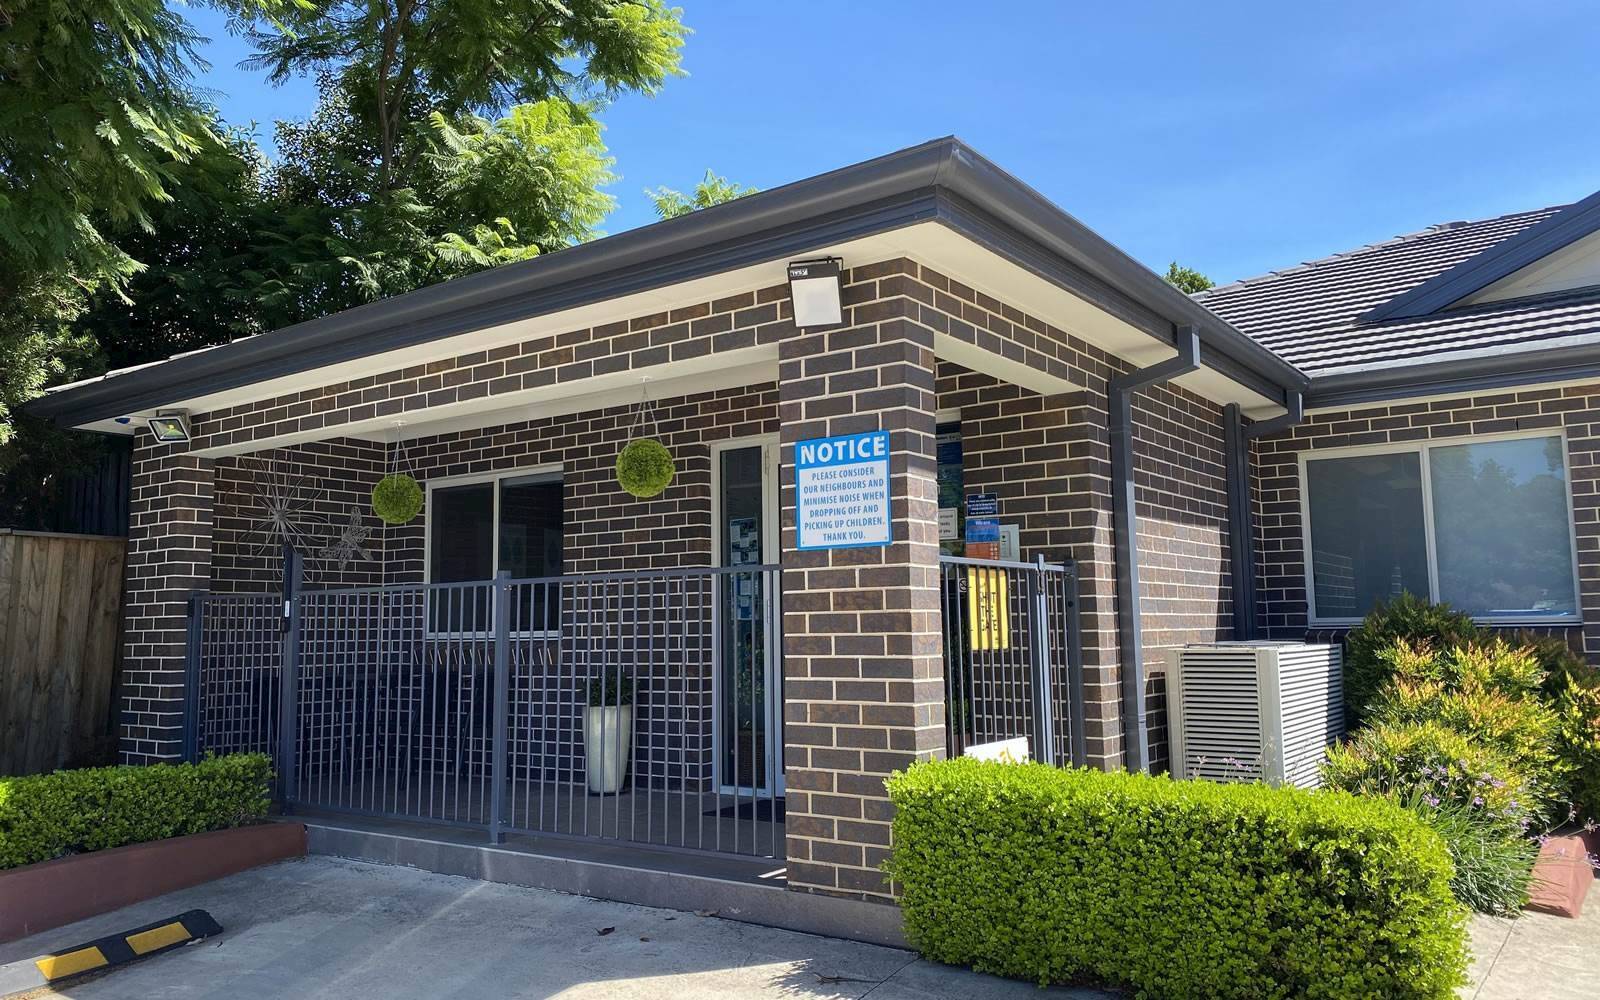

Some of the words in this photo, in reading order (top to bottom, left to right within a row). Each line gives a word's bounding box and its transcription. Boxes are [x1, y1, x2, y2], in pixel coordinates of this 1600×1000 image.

[801, 436, 885, 464] NOTICE
[812, 470, 837, 481] PLEASE
[839, 467, 874, 478] CONSIDER
[820, 481, 866, 492] NEIGHBOURS
[868, 479, 883, 487] AND
[804, 496, 837, 506] MINIMISE
[840, 493, 860, 503] NOISE
[862, 492, 884, 500] WHEN
[810, 507, 846, 518] DROPPING
[848, 506, 861, 514] OFF
[863, 505, 878, 513] AND
[804, 521, 832, 530] PICKING
[846, 517, 885, 526] CHILDREN.
[823, 533, 846, 541] THANK
[849, 531, 866, 539] YOU.
